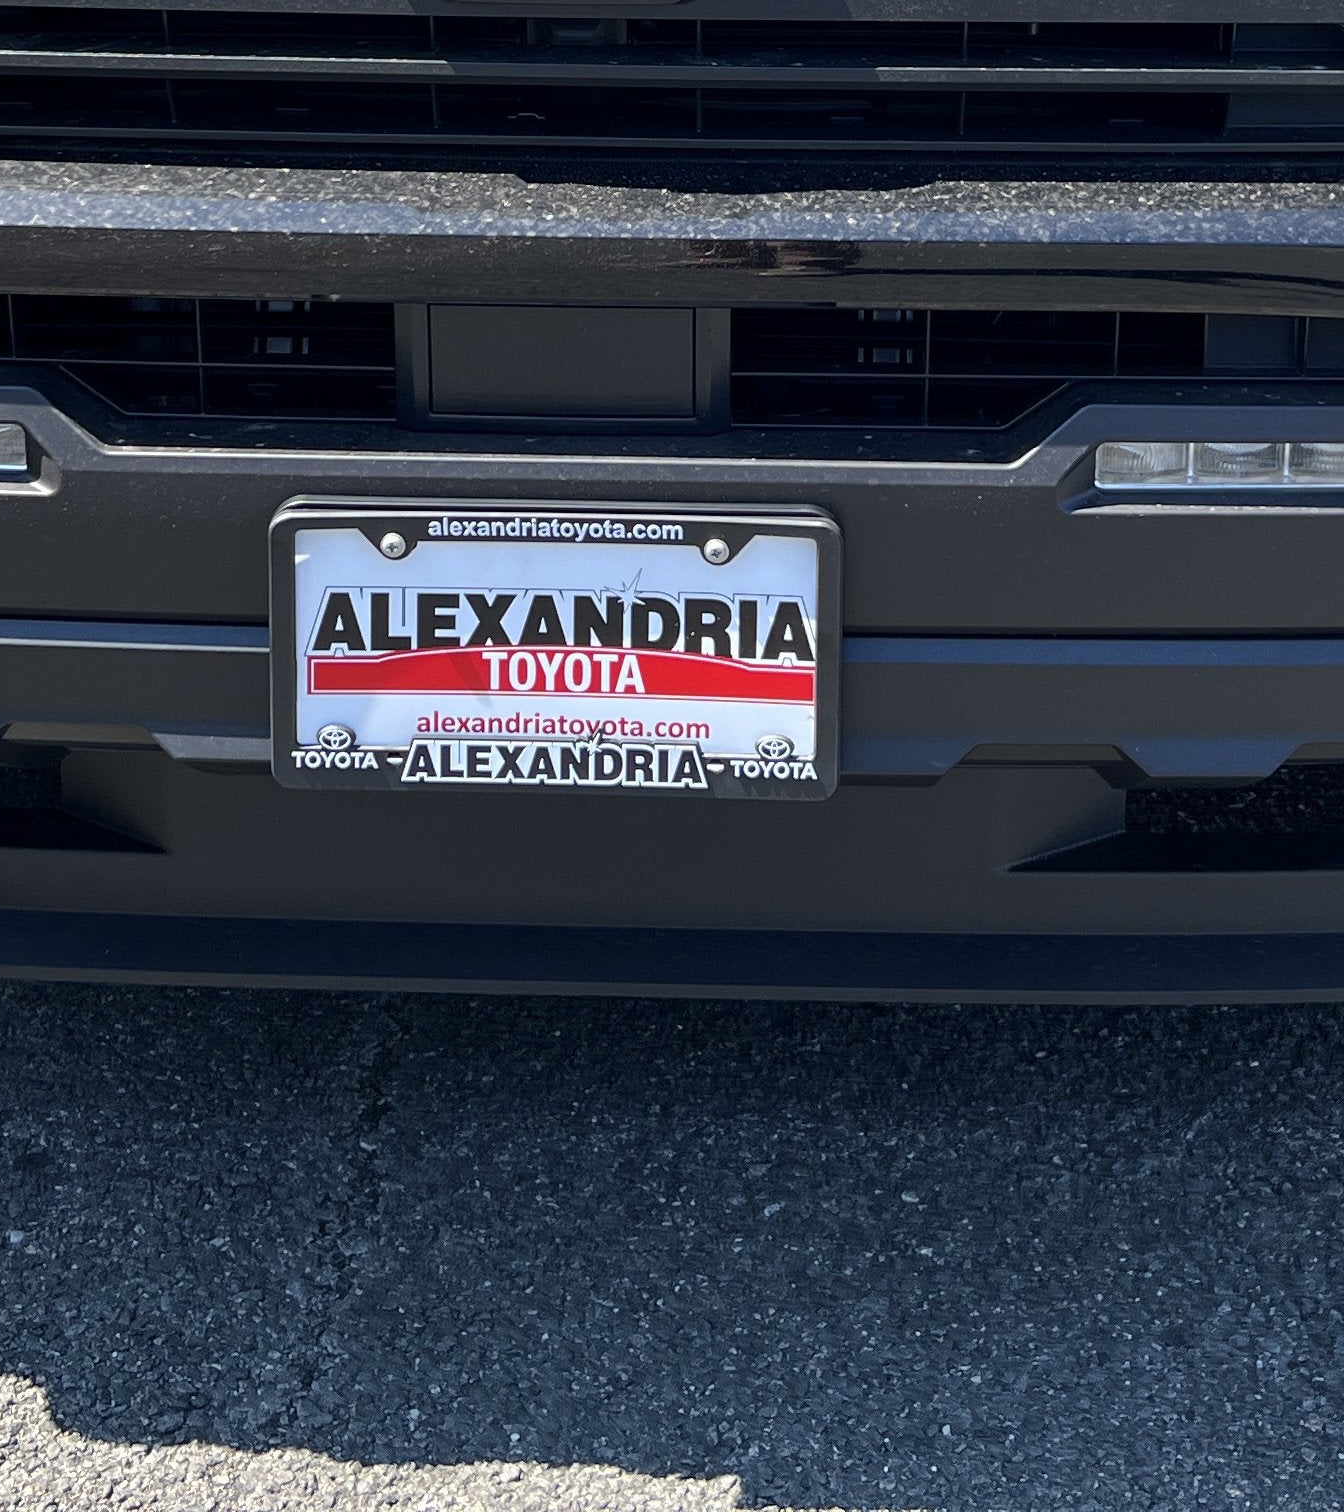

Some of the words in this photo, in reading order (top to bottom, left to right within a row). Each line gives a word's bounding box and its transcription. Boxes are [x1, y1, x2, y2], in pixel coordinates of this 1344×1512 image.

[427, 517, 684, 541] alexandriatoyota.com
[311, 589, 816, 663] ALEXANDRIA
[482, 651, 646, 694] TOYOTA
[416, 710, 711, 740] alexandriatoyota.com
[291, 750, 379, 770] TOYOTA
[403, 742, 706, 786] ALEXANDRIA
[729, 759, 818, 781] TOYOTA
